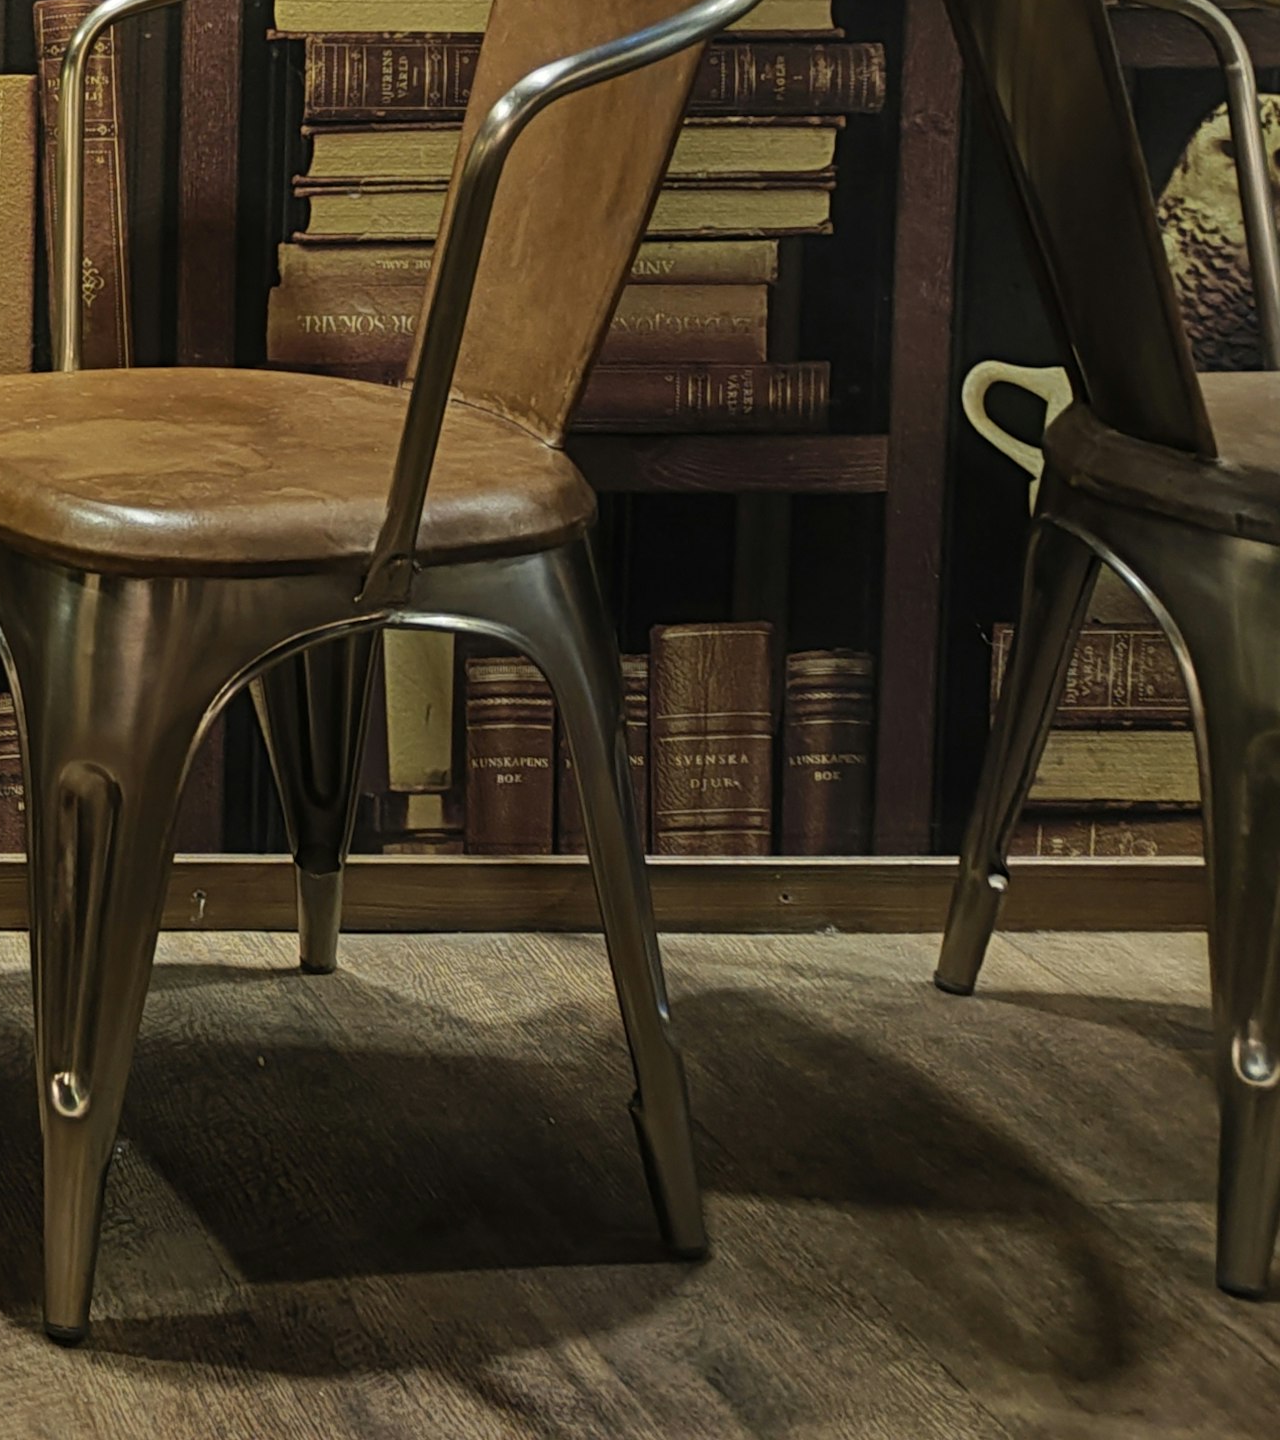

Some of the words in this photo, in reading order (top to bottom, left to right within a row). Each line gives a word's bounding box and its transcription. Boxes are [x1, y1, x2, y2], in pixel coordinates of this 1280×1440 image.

[382, 49, 395, 104] DJURENS
[396, 56, 408, 98] VÄRLD
[471, 758, 550, 770] KUNSKAPENS
[674, 753, 750, 766] SVENSKA
[496, 773, 523, 785] BOK
[813, 770, 842, 782] BOK
[689, 778, 735, 790] DJUR
